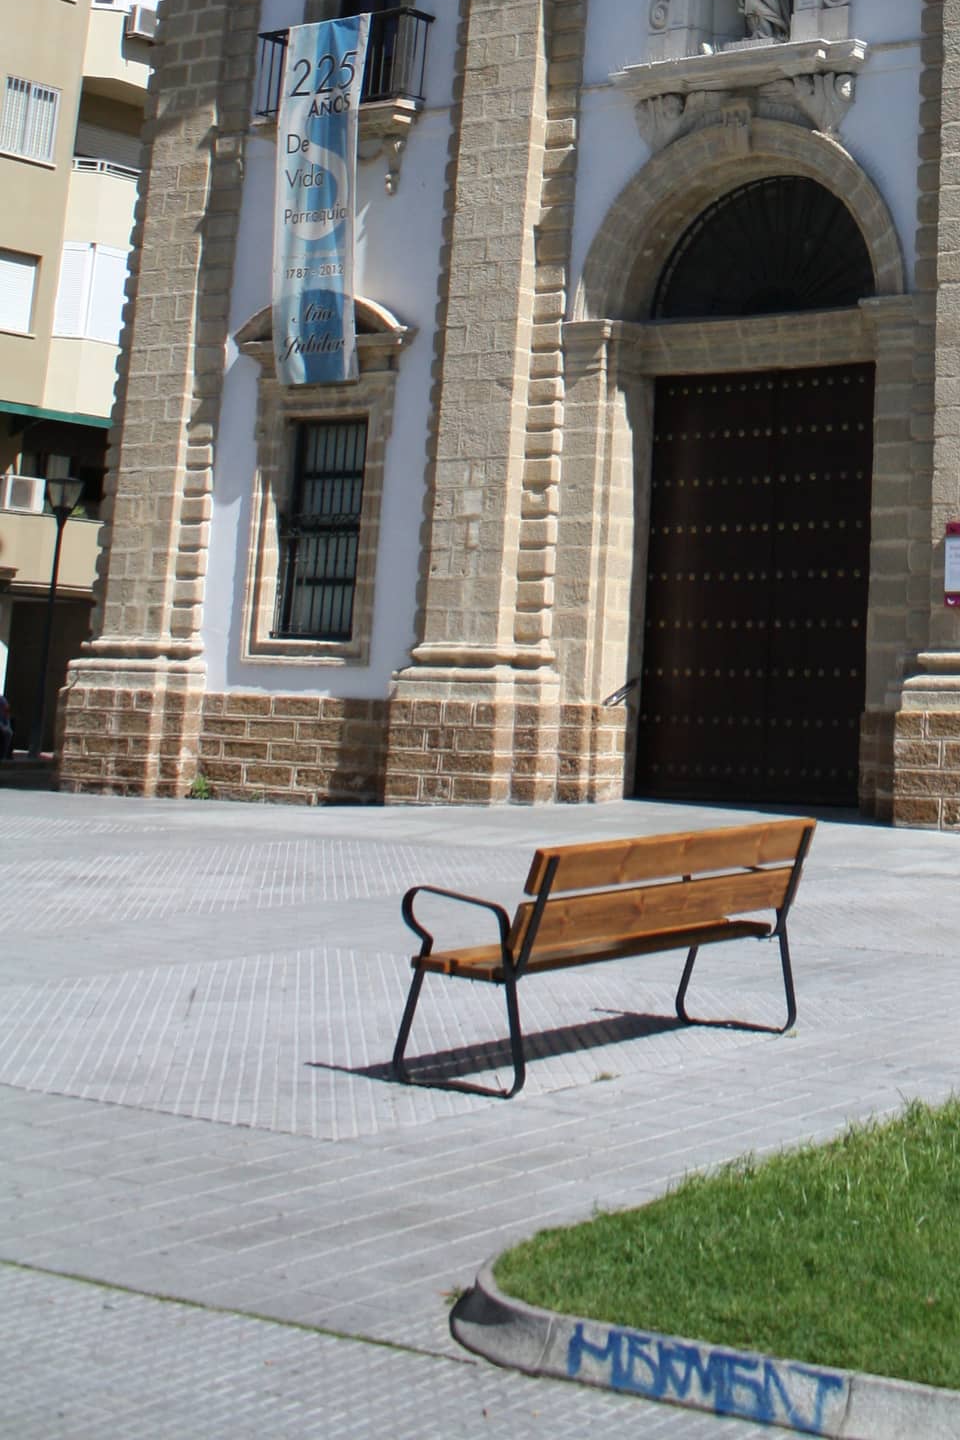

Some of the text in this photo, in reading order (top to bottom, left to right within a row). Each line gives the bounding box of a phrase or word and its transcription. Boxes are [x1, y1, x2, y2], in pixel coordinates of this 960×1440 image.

[290, 49, 359, 97] 225
[308, 92, 351, 118] AÑOS
[286, 133, 310, 154] De
[285, 163, 324, 188] Vida
[284, 203, 347, 226] Parroquia
[320, 264, 344, 277] 2012
